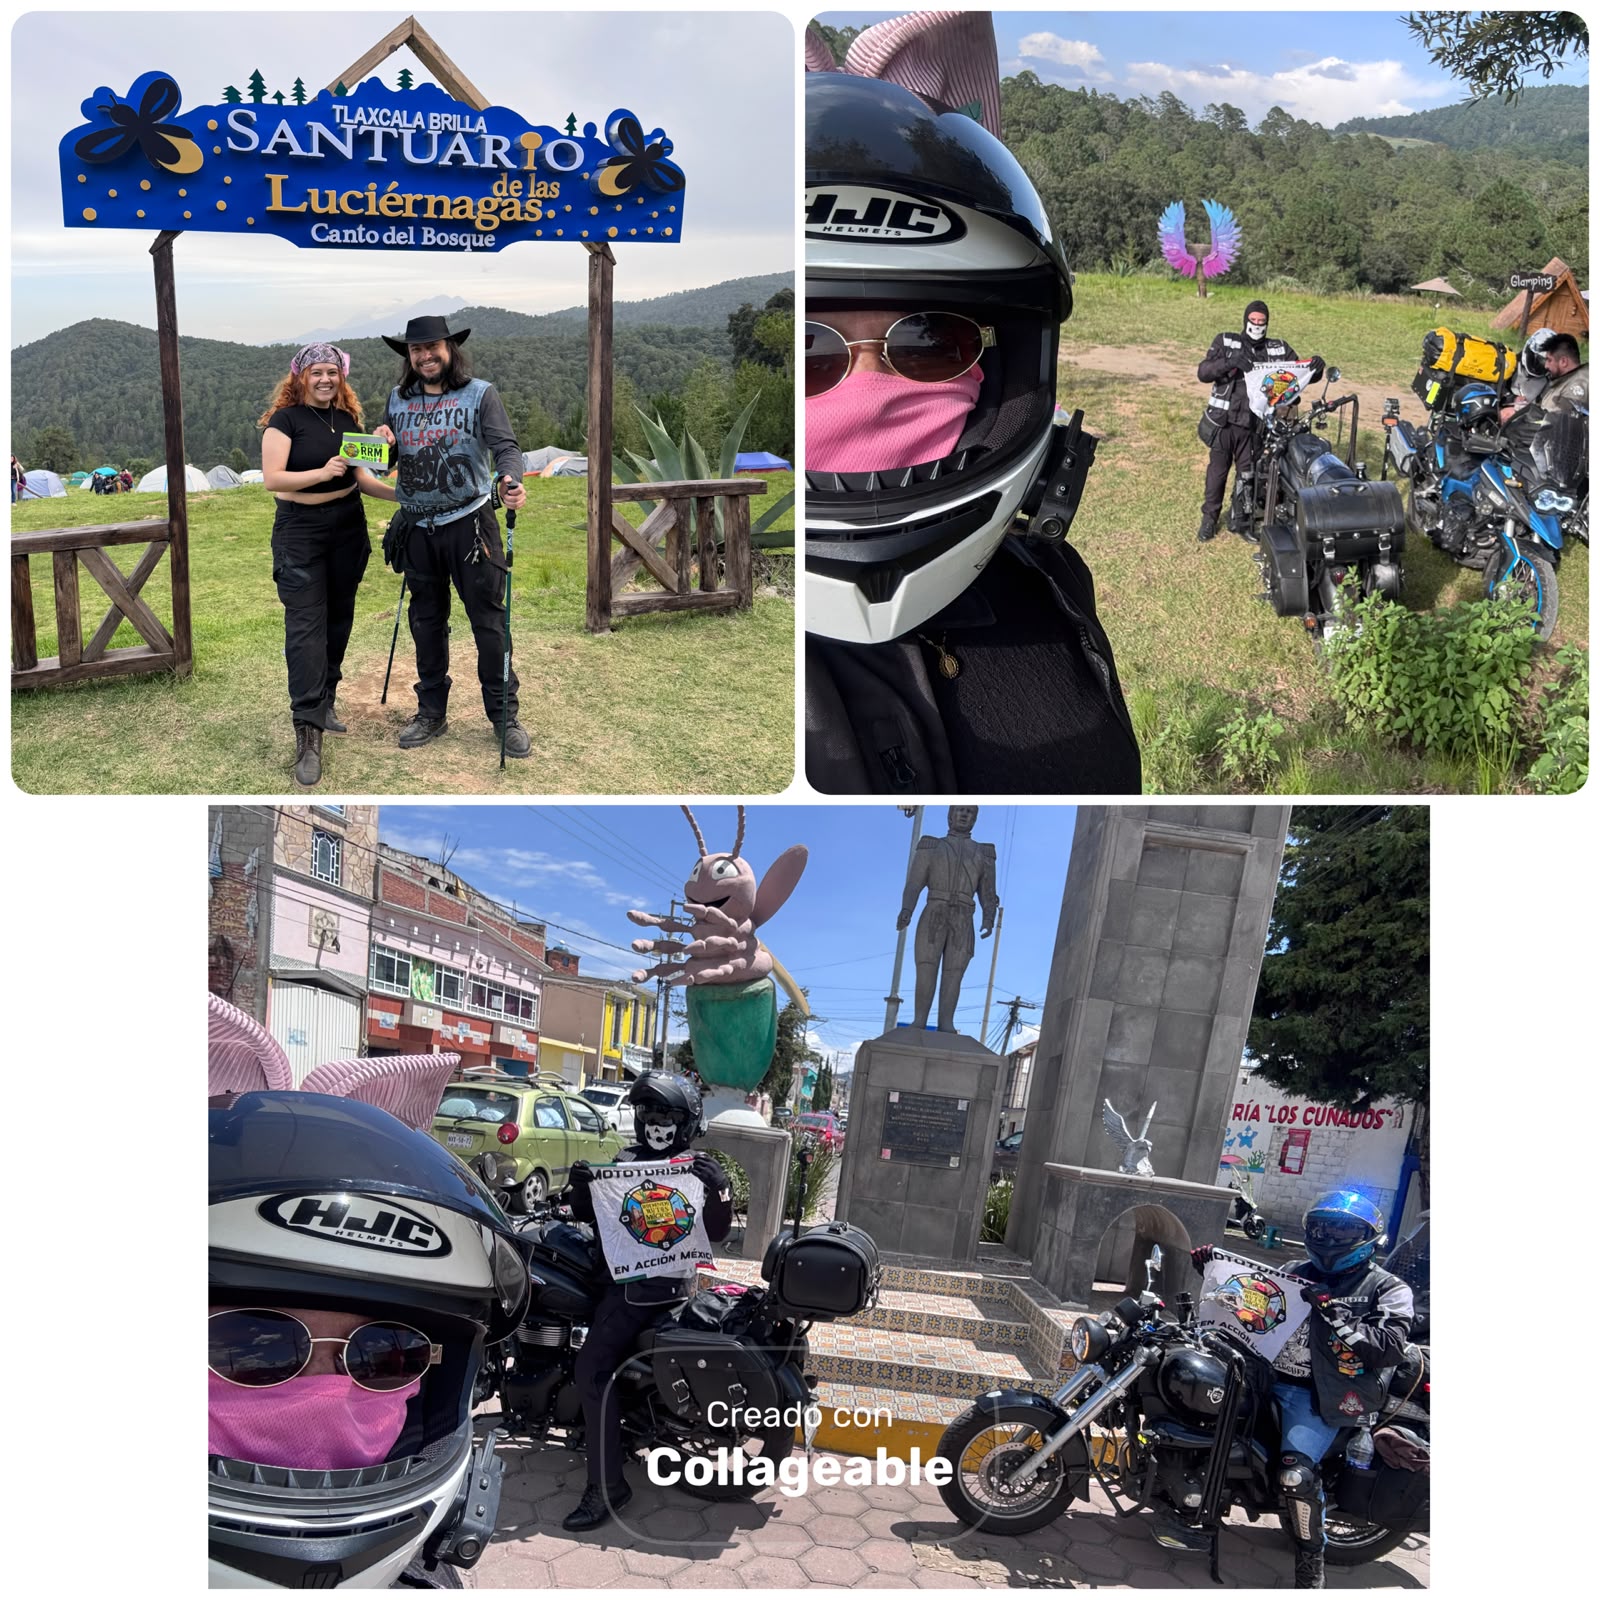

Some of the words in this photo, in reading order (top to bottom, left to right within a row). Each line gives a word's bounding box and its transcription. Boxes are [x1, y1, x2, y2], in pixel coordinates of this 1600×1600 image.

[332, 104, 424, 129] TLAXCALA
[429, 113, 487, 134] BRILLA
[493, 172, 524, 198] de
[528, 174, 560, 200] las
[265, 173, 543, 231] Luciérnagas
[311, 223, 384, 245] Canto
[387, 224, 415, 246] del
[421, 227, 496, 252] Bosque
[823, 226, 902, 237] HELMETS
[1511, 274, 1553, 291] Glamping
[407, 398, 459, 413] AUTHENTIC
[402, 428, 459, 447] CLASSIC
[361, 447, 382, 458] RRM
[1232, 1099, 1260, 1122] RÍA
[592, 1165, 694, 1181] MOTOTURISM
[644, 1182, 654, 1190] N
[288, 1198, 436, 1249] HJC
[335, 1229, 404, 1248] HELMETS
[614, 1265, 630, 1275] EN
[635, 1253, 676, 1269] ACCIÓN
[680, 1248, 713, 1260] MÉXIC
[1207, 1252, 1313, 1288] OTOTURISM
[1254, 1273, 1264, 1281] N
[1200, 1319, 1216, 1327] EN
